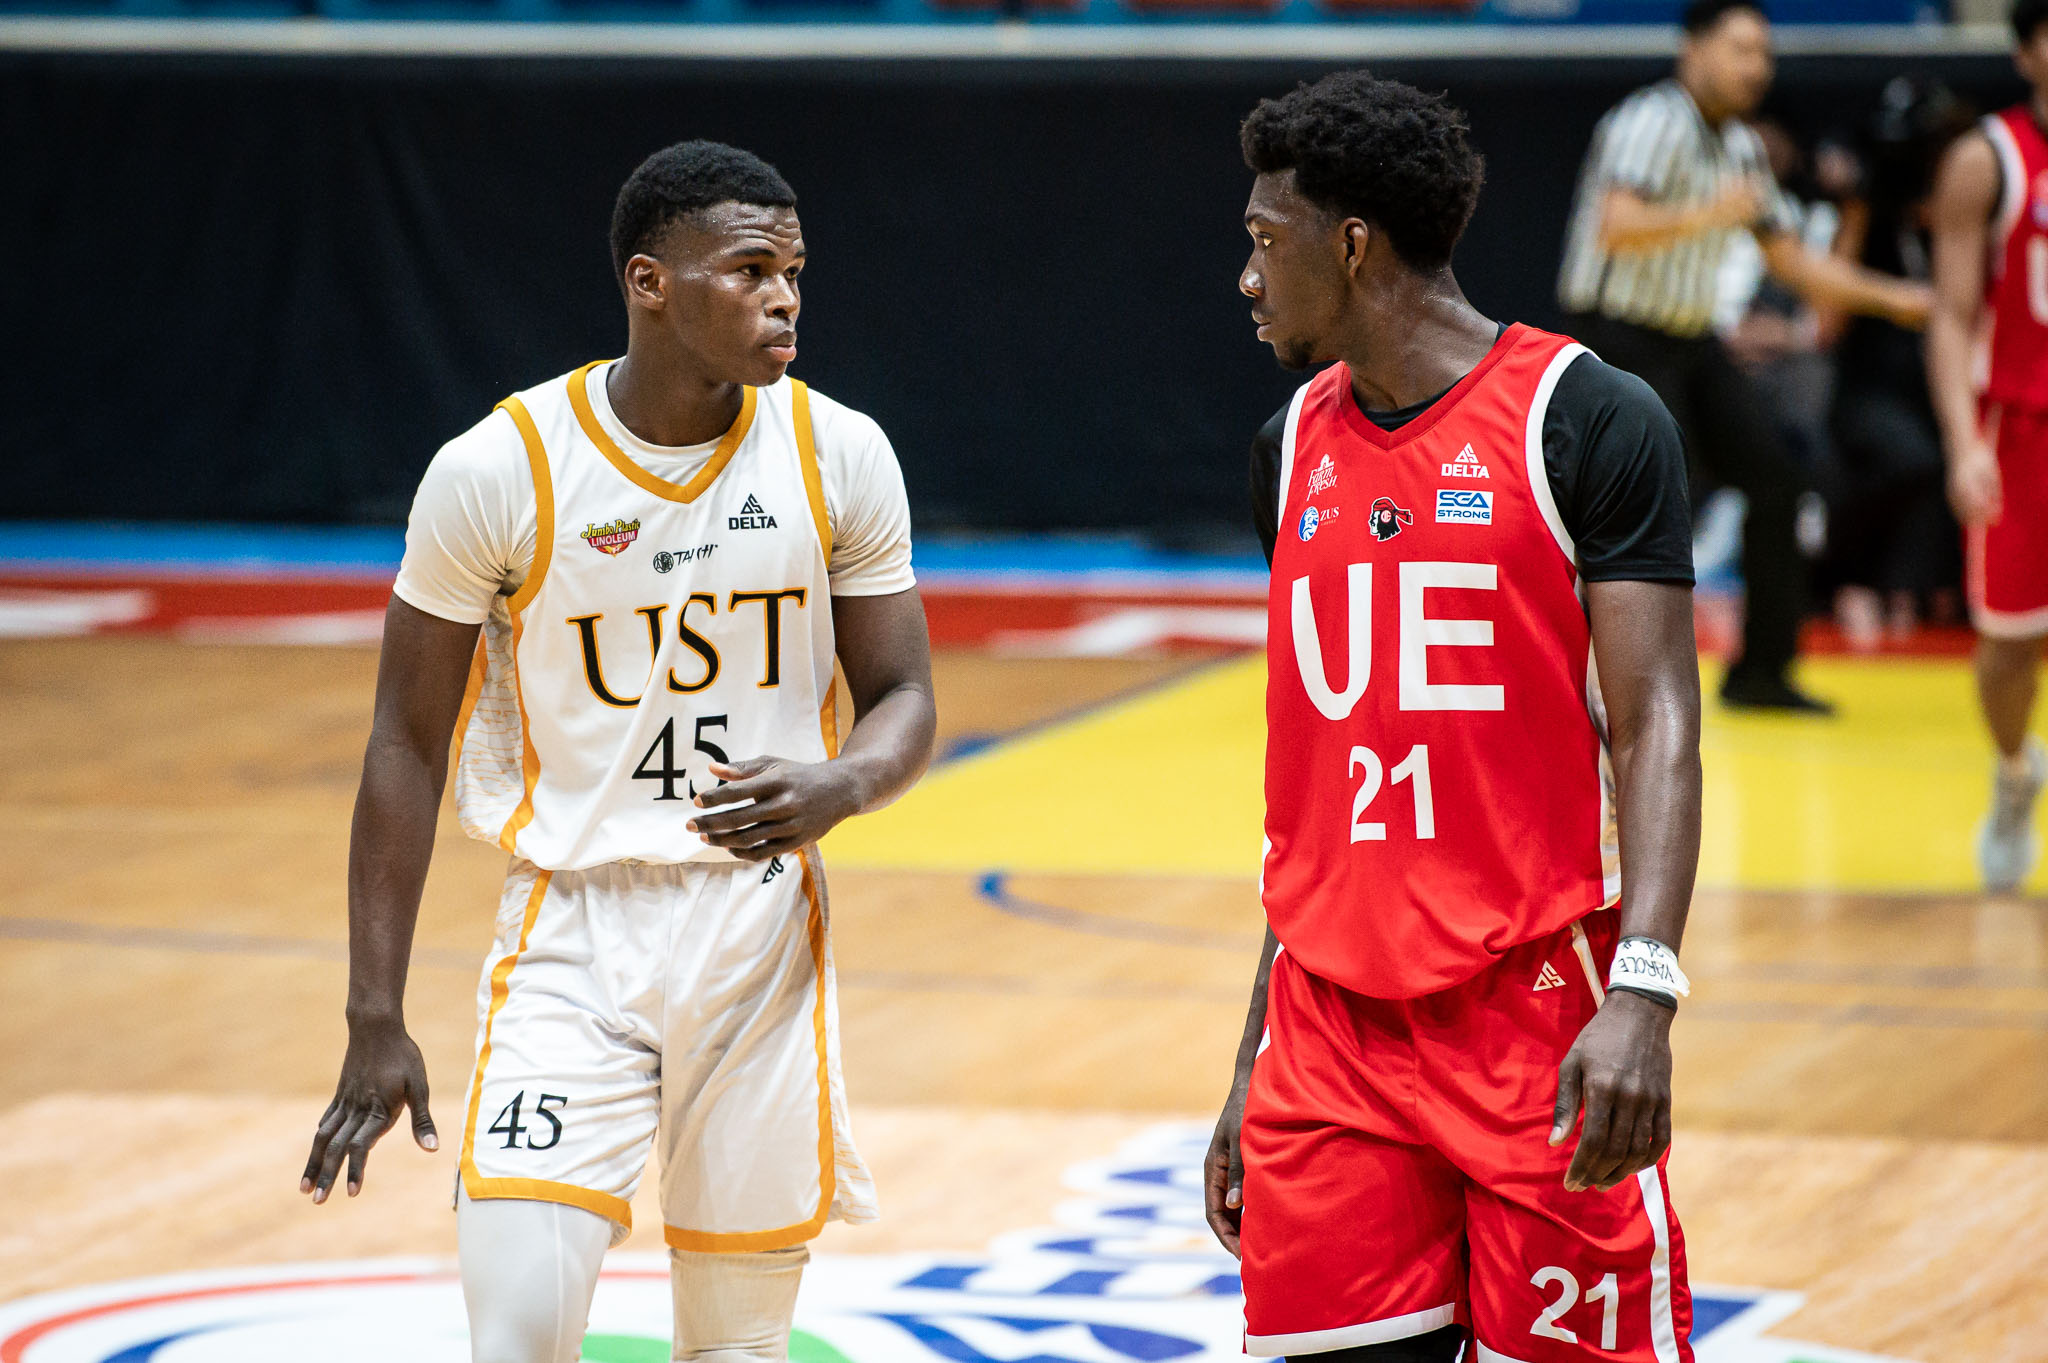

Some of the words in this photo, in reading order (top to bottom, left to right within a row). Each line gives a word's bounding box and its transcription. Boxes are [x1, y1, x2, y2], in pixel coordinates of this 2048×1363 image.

[1441, 463, 1490, 479] DELTA
[1439, 491, 1489, 508] SGA
[729, 515, 777, 530] DELTA
[1320, 506, 1340, 521] ZUS
[1437, 509, 1491, 520] STRONG
[580, 523, 614, 539] Jumbo
[615, 518, 641, 533] Plastic
[591, 531, 636, 547] LINOLEUM
[565, 586, 808, 710] UST
[1291, 561, 1504, 721] UE
[631, 713, 731, 801] 45
[1348, 744, 1436, 845] 21
[487, 1089, 569, 1151] 45
[1529, 1265, 1620, 1351] 21
